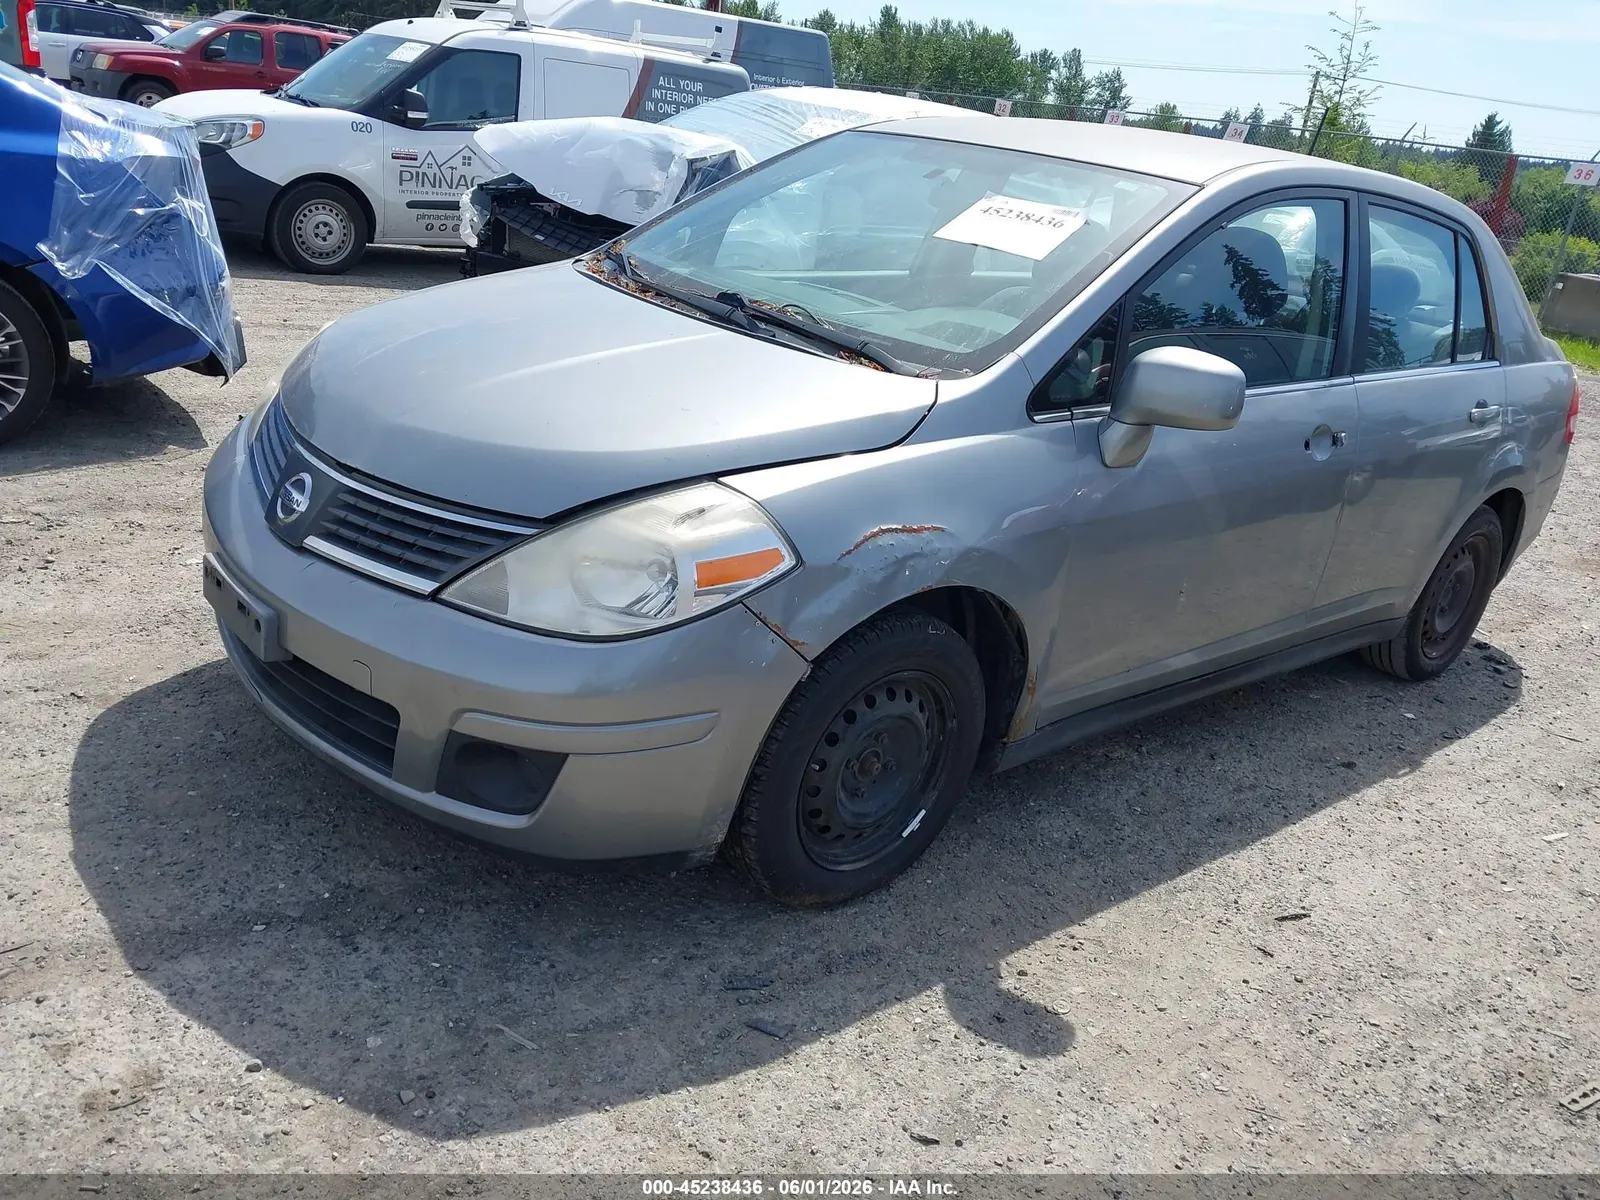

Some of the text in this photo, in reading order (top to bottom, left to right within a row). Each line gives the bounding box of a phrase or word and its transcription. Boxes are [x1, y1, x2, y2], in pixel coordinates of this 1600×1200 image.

[659, 76, 703, 92] ALL YOUR
[652, 88, 694, 104] INTERIOR
[645, 101, 655, 111] IN
[657, 103, 677, 114] ONE
[997, 103, 1007, 113] 32
[1108, 114, 1120, 124] 33
[350, 120, 373, 133] 020
[1231, 127, 1244, 139] 34
[1574, 168, 1594, 180] 36
[979, 206, 1065, 229] 45238436
